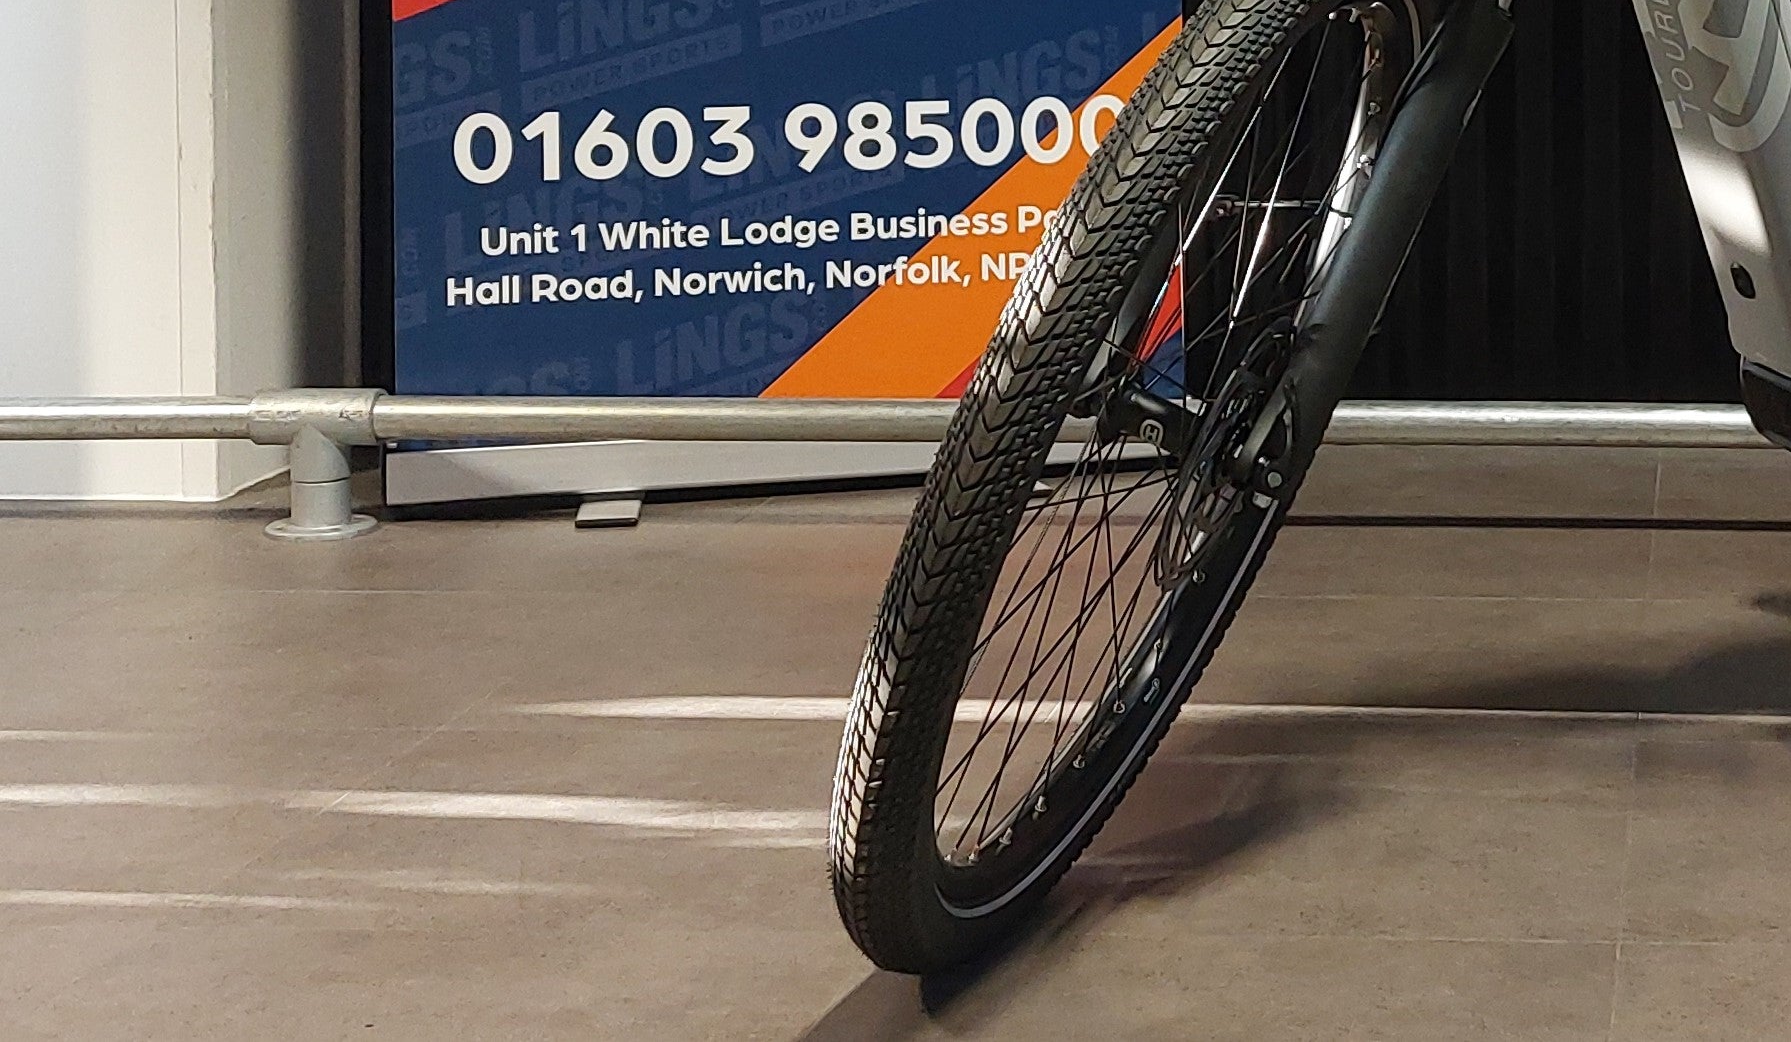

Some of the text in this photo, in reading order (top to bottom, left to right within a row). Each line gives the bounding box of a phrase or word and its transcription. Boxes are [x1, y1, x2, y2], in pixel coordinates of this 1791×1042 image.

[452, 104, 757, 186] 01603
[480, 221, 559, 256] Unit
[570, 223, 588, 252] 1
[599, 217, 709, 251] White
[720, 214, 839, 249] Lodge
[850, 208, 1008, 240] Business
[446, 273, 520, 307] Hall
[531, 270, 643, 303] Road,
[654, 263, 815, 297] Norwich,
[825, 255, 971, 289] Norfolk,
